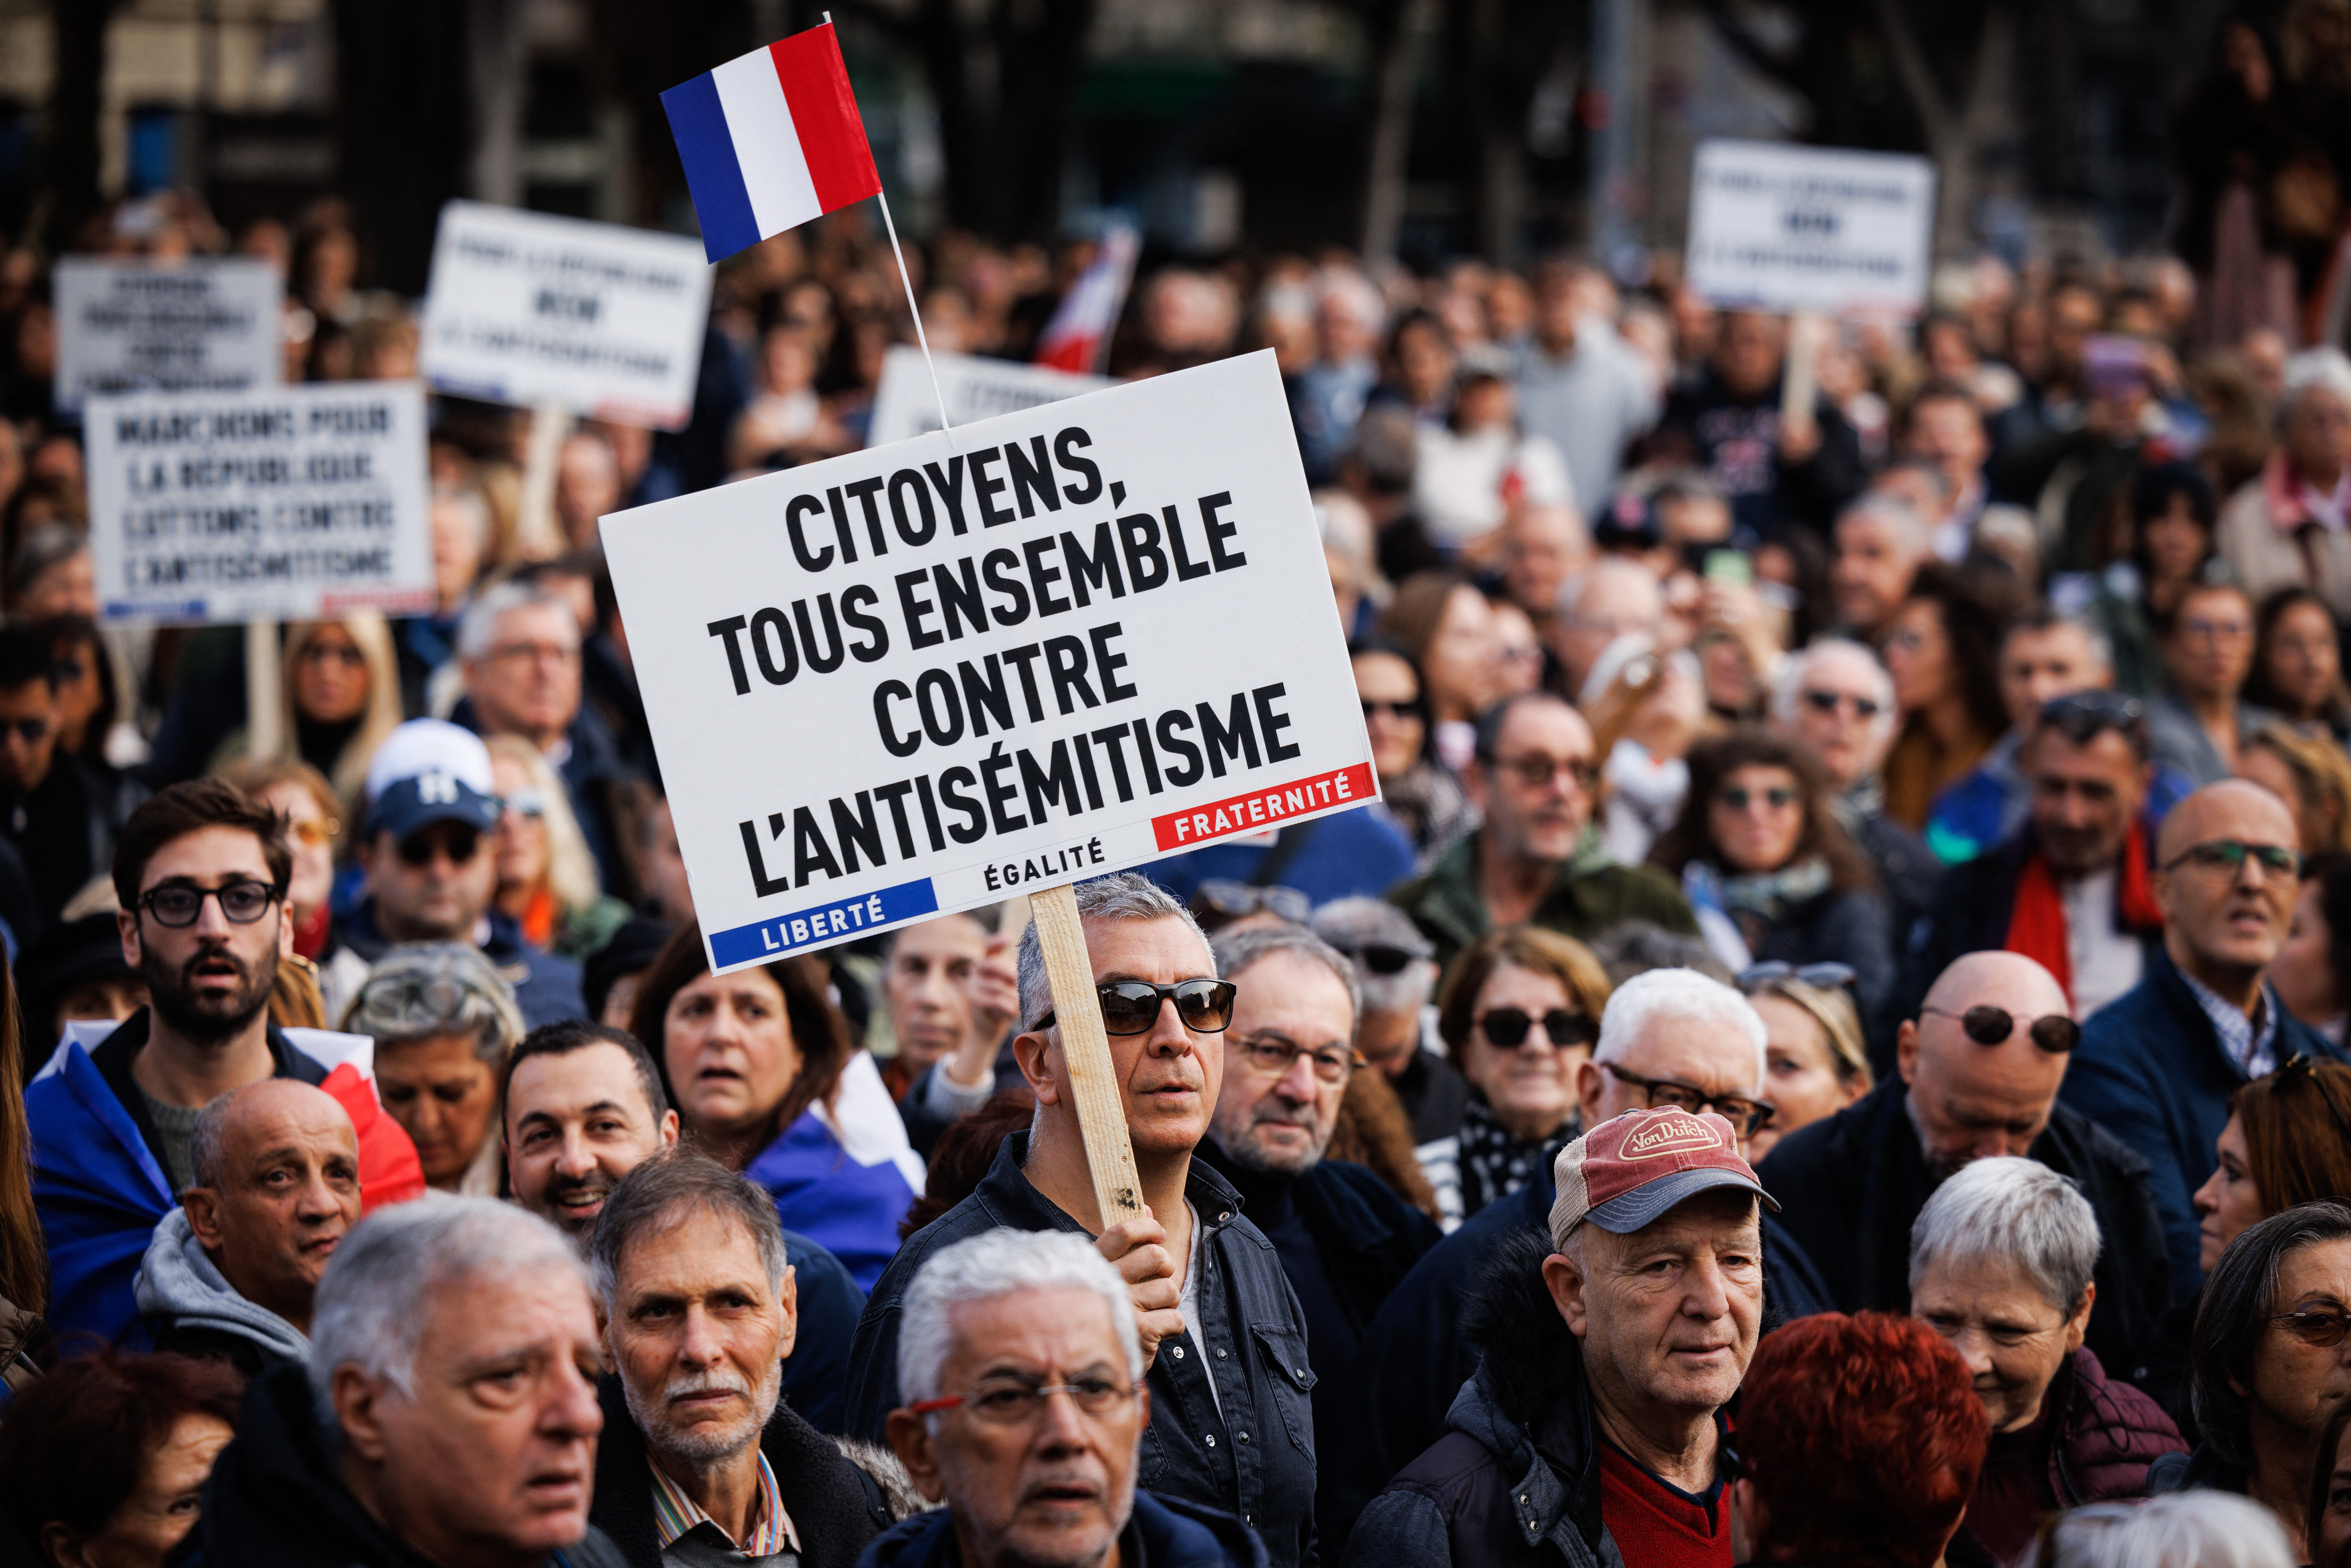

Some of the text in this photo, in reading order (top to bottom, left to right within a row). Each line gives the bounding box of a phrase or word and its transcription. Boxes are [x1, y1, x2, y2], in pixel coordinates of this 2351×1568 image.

[116, 403, 389, 444] MARCHONS POUR
[129, 459, 167, 491] LA
[275, 499, 394, 536] CONTRE
[786, 426, 1127, 573] CITOYENS,
[706, 490, 1248, 696] TOUS ENSEMBLE
[873, 621, 1138, 757] CONTRE
[739, 681, 1301, 898] L'ANTISÉMITISME
[761, 771, 1352, 951] LIBERTÉ ÉGALITÉ FRATERNITÉ
[1630, 1119, 1710, 1148] Von Dutch
